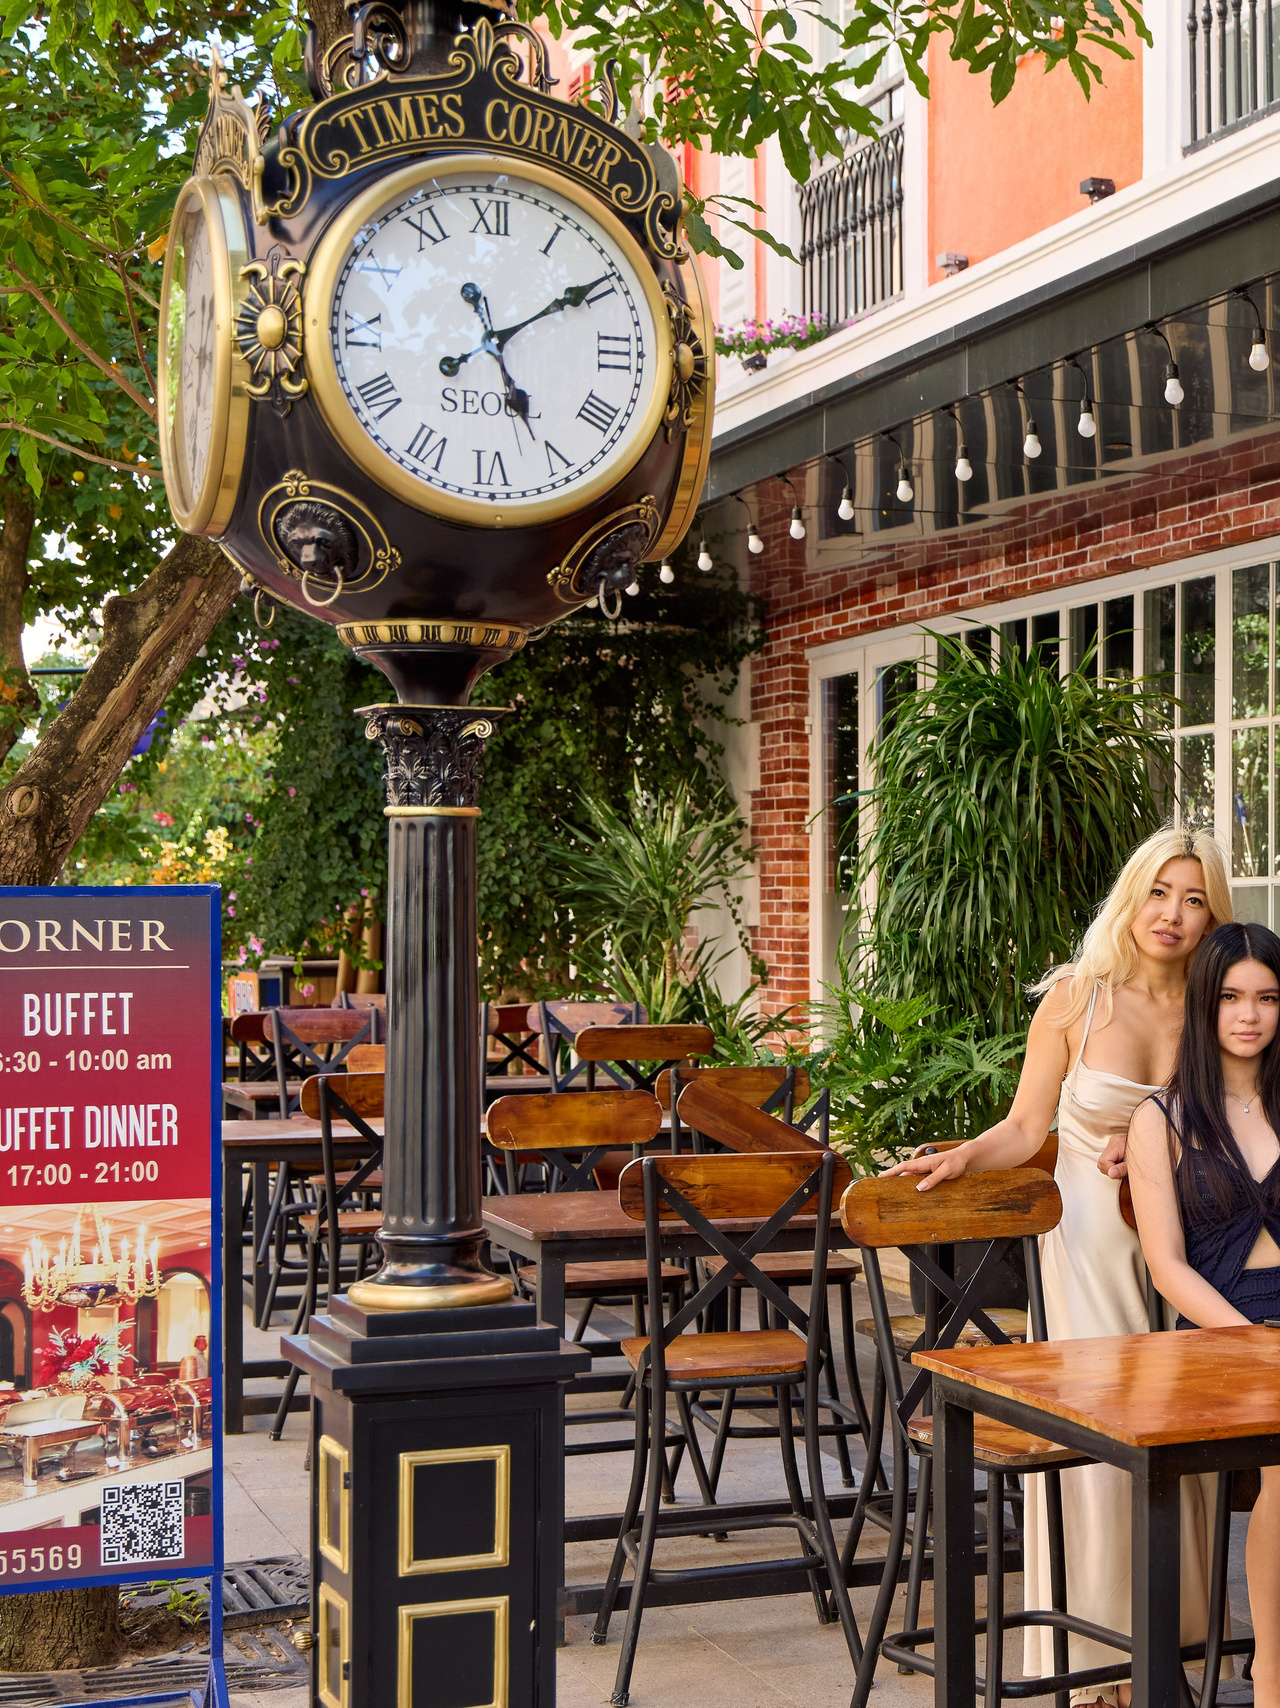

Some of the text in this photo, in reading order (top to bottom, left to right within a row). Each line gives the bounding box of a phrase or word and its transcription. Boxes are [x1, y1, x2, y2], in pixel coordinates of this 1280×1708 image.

[340, 94, 622, 186] TIMES CORNER
[0, 919, 174, 952] ORNER
[23, 992, 134, 1037] BUFFET
[0, 1050, 41, 1073] :30
[65, 1049, 129, 1071] 10:00
[136, 1052, 172, 1070] am
[85, 1103, 178, 1148] DINNER
[7, 1163, 72, 1187] 17:00
[94, 1160, 159, 1184] 21:00
